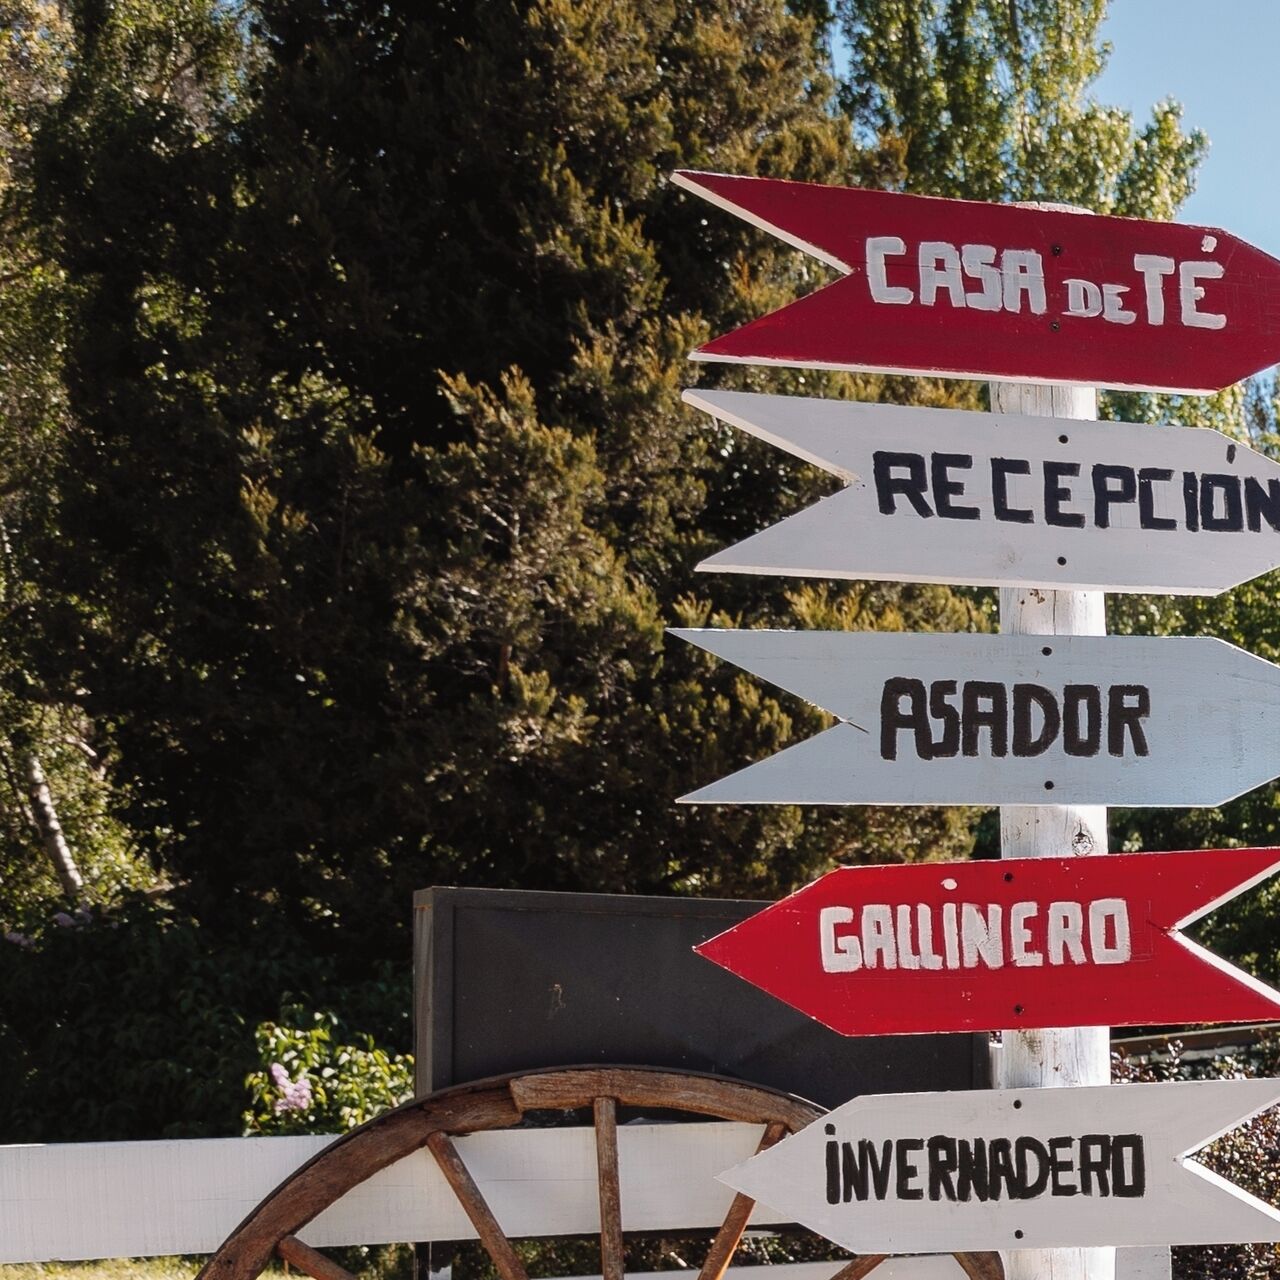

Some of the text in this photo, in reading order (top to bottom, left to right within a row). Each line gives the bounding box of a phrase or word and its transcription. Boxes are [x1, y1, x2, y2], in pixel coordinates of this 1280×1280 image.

[864, 236, 1047, 315] CASA
[1133, 235, 1228, 330] TÉ
[880, 676, 1151, 761] ASADOR
[819, 878, 1130, 974] GALLINERO
